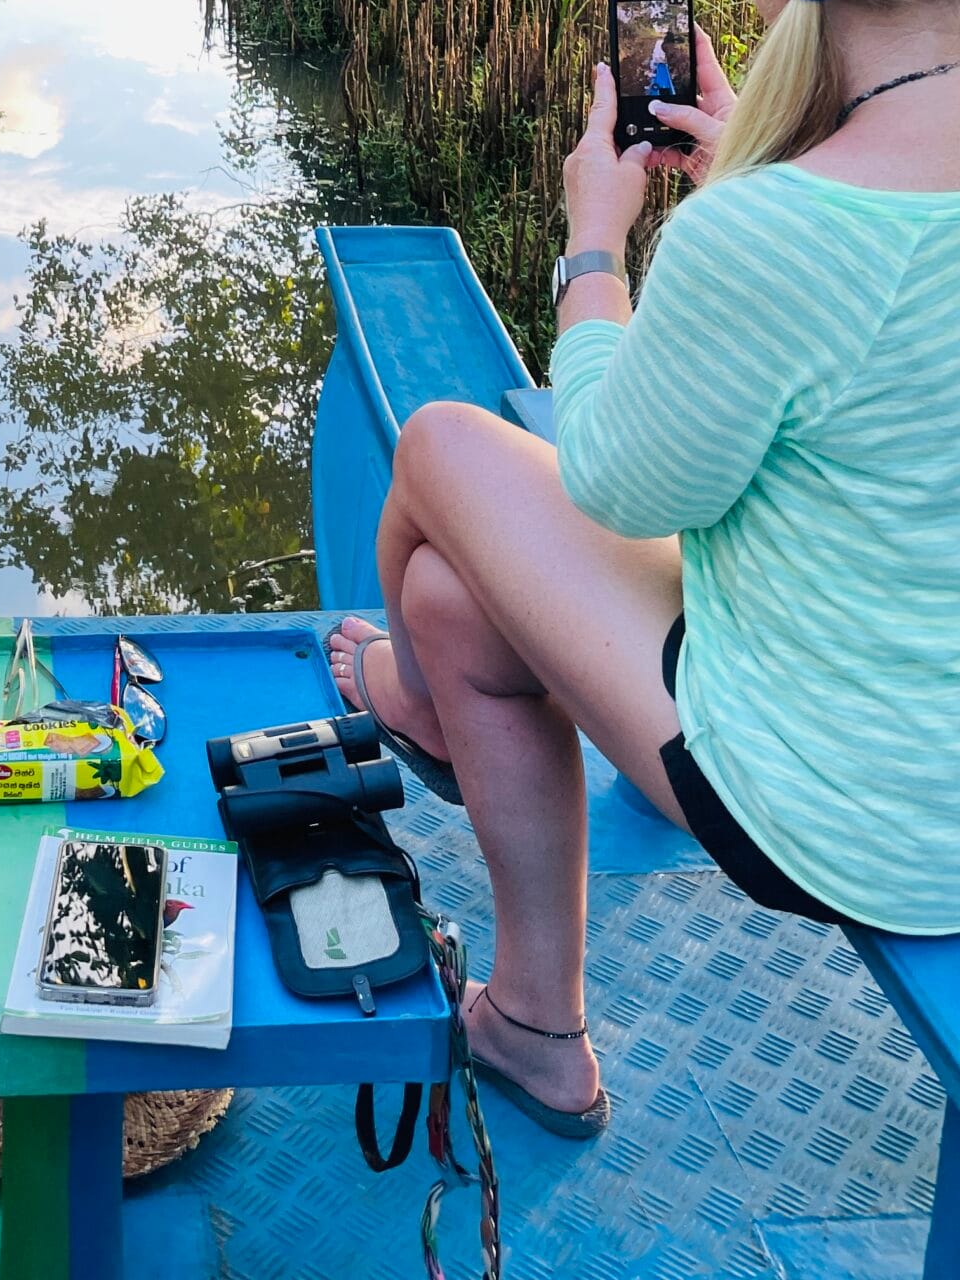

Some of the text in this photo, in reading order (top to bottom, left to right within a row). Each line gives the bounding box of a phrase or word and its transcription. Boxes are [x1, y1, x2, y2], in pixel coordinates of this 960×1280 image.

[75, 832, 227, 852] HELM FIELD GUIDES
